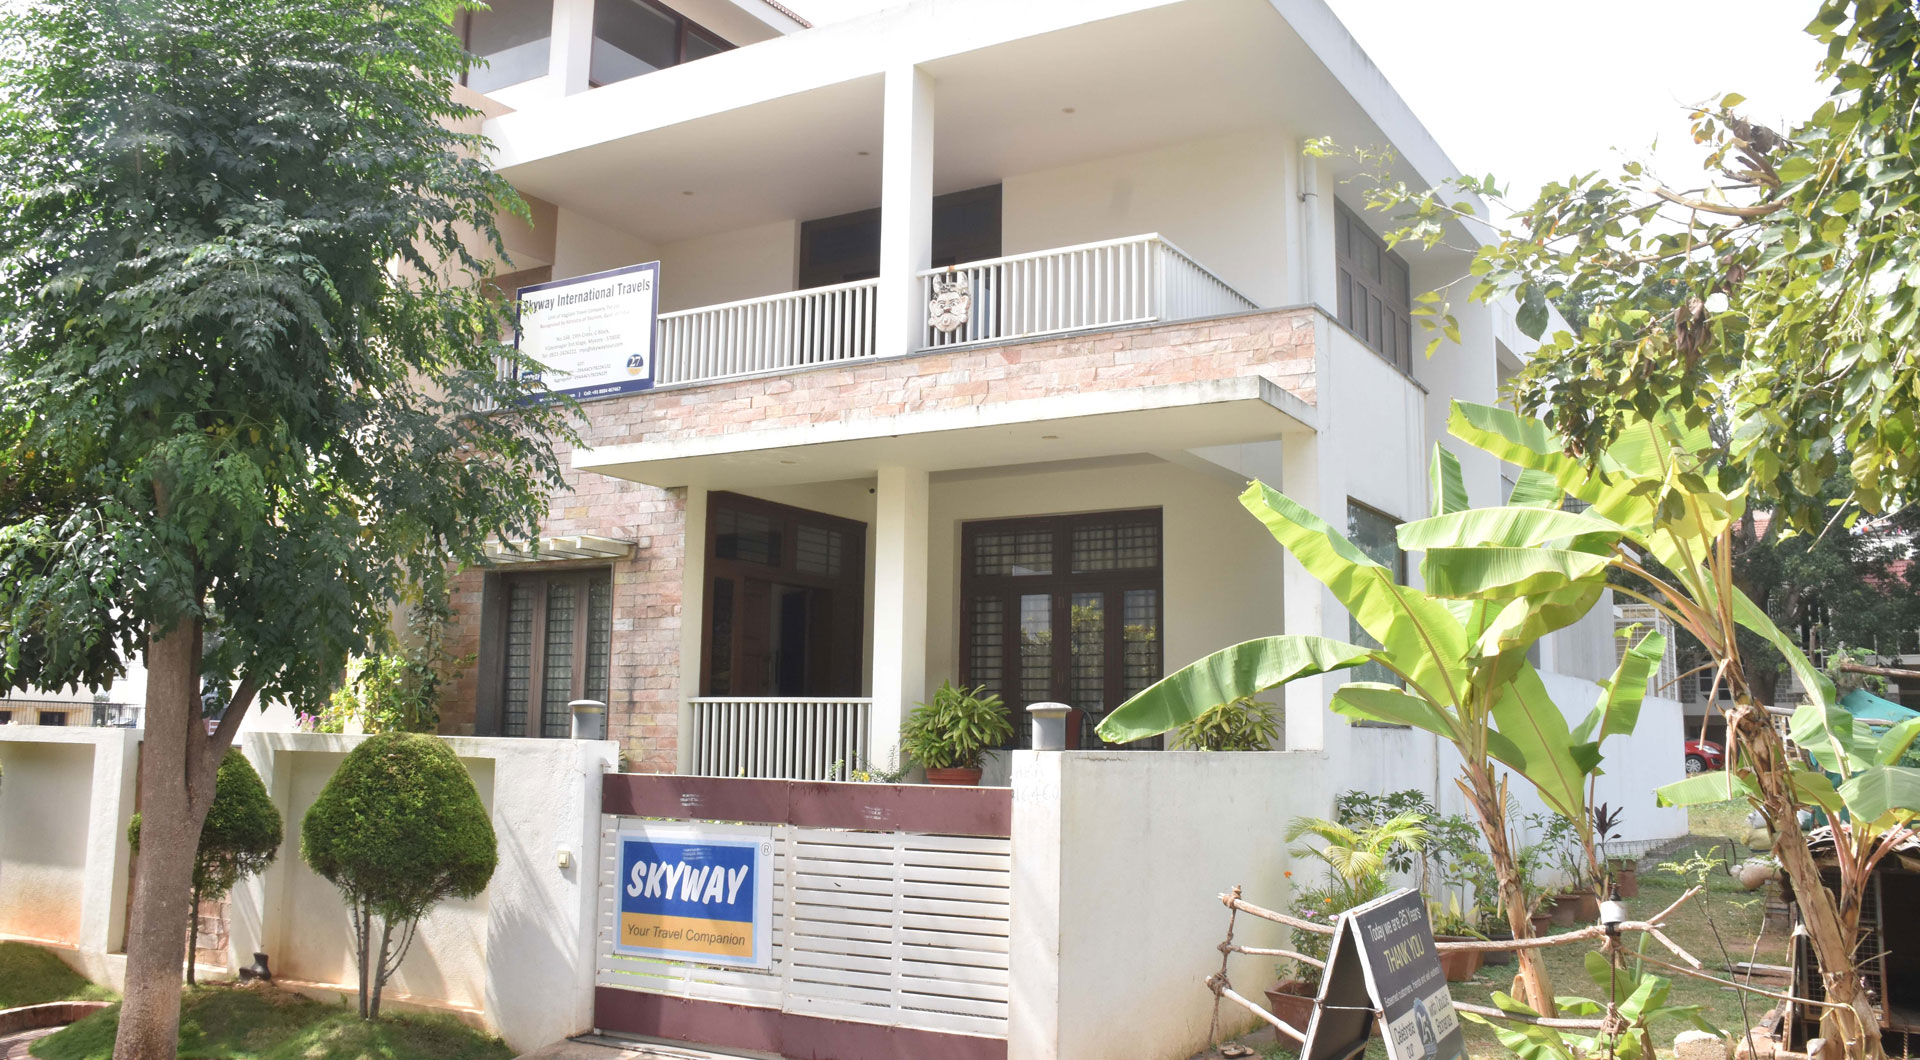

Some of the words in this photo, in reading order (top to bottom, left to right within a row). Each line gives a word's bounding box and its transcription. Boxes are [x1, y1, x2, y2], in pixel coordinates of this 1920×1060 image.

[523, 298, 554, 313] Skyway
[557, 284, 614, 306] International
[617, 278, 650, 295] Travels
[629, 355, 641, 367] 27
[626, 860, 749, 905] SKYWAY
[627, 924, 650, 937] Your
[653, 925, 683, 939] Travel
[685, 928, 745, 946] Companion
[1368, 922, 1386, 942] Today
[1384, 921, 1393, 935] we
[1392, 917, 1400, 931] are
[1399, 910, 1409, 928] 25
[1405, 908, 1422, 923] Years
[1383, 940, 1412, 974] THANK
[1407, 933, 1425, 960] YOU
[1394, 1020, 1415, 1045] Celebrate
[1406, 1043, 1414, 1059] our
